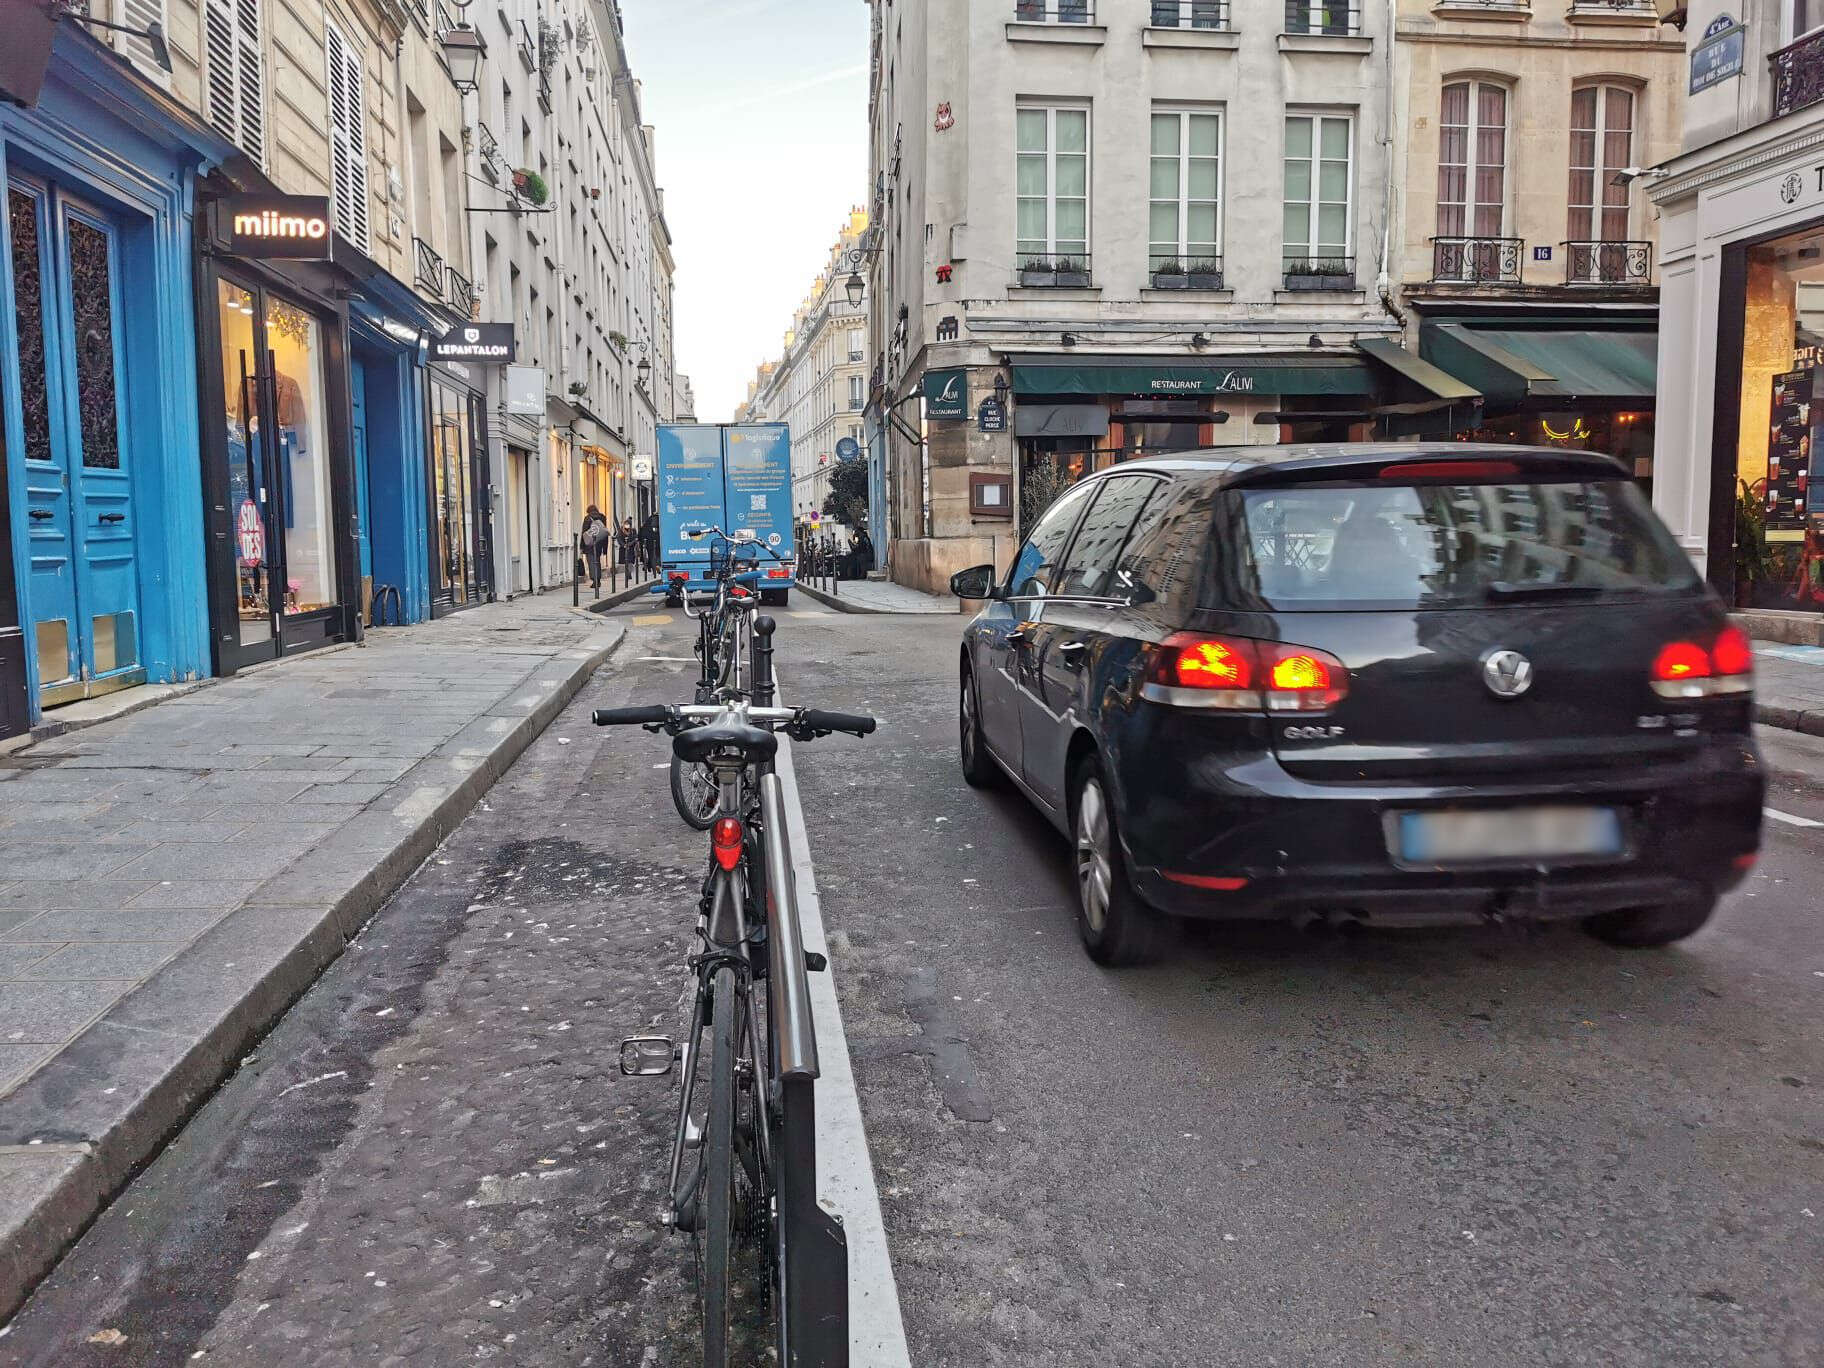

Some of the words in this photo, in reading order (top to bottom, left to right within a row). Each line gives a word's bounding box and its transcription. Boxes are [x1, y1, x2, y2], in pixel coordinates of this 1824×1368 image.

[234, 210, 326, 238] miimo
[1537, 248, 1548, 259] 16
[1151, 379, 1202, 389] RESTAURANT
[240, 503, 259, 532] SOL
[242, 531, 262, 560] DES
[769, 535, 780, 543] 90
[1283, 726, 1346, 739] GOLF
